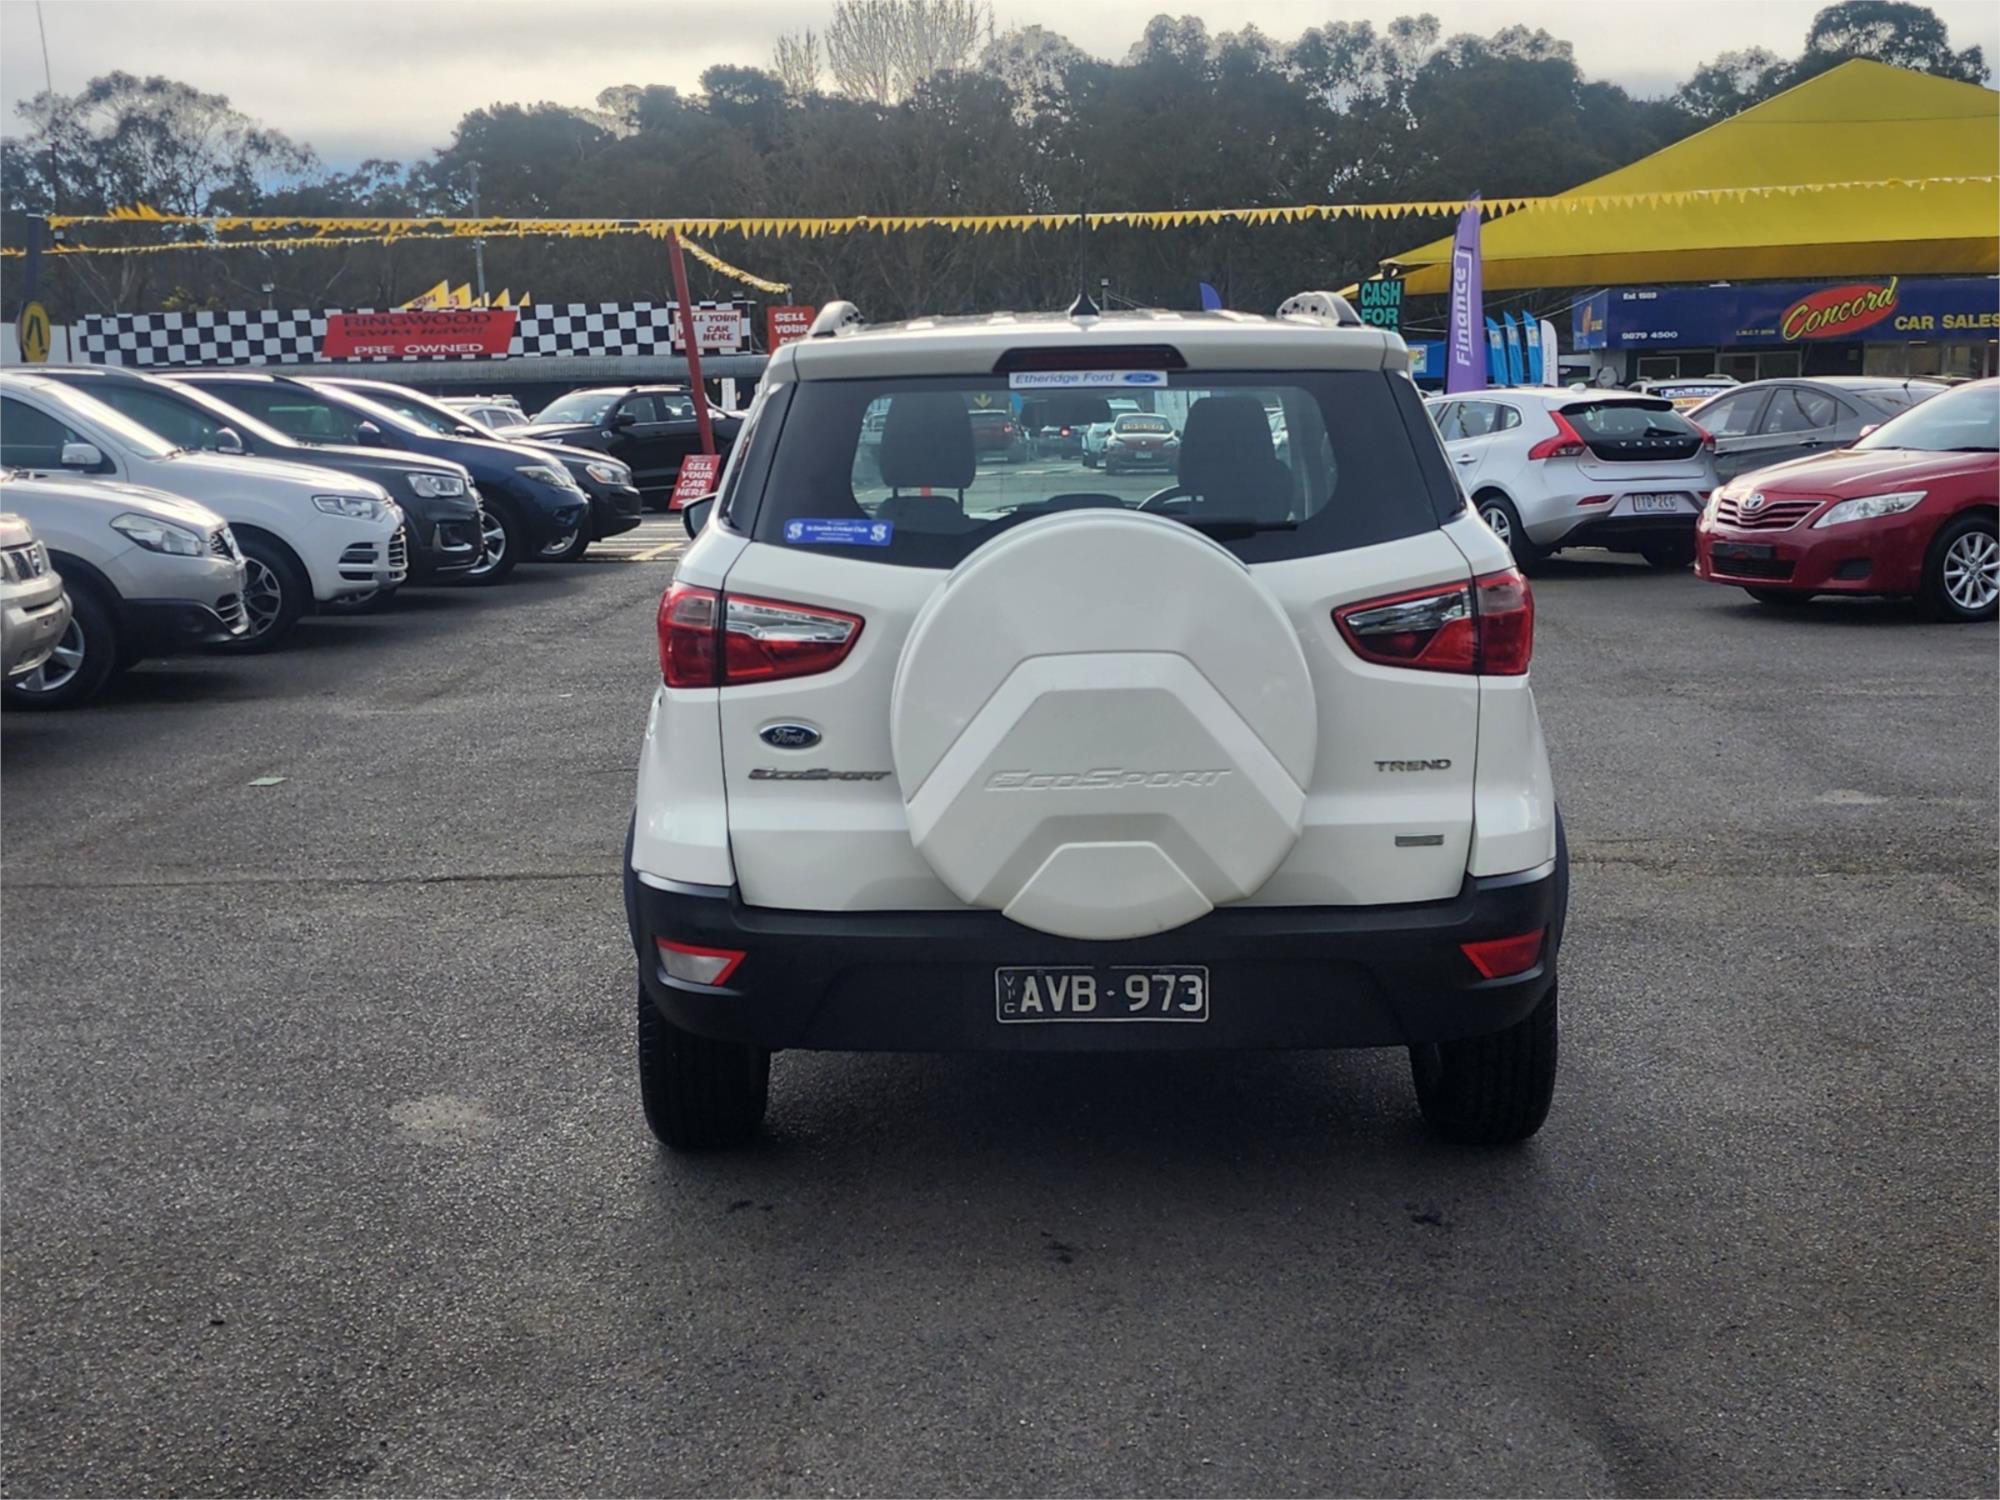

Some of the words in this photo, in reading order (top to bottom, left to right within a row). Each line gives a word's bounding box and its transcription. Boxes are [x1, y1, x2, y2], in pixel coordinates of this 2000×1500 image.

[1361, 281, 1401, 306] CASH
[1783, 276, 1898, 342] Concord
[343, 312, 492, 328] RINGWOOD
[709, 314, 738, 322] YOUR
[774, 312, 807, 322] SELL
[1361, 308, 1398, 325] FOR
[1455, 267, 1471, 367] Finance
[1894, 315, 1935, 331] CAR
[1941, 312, 2000, 329] SALES
[774, 324, 809, 334] YOUR
[703, 333, 734, 341] HERE
[1650, 331, 1678, 339] 4500
[354, 345, 395, 355] PRE
[403, 343, 484, 354] OWNED
[1015, 374, 1079, 384] Etheridge
[1083, 373, 1115, 382] Ford
[1619, 440, 1684, 448] VOLVO
[687, 462, 713, 470] SELL
[681, 471, 713, 480] YOUR
[680, 479, 706, 488] CAR
[675, 488, 707, 497] HERE
[1374, 759, 1451, 772] TREND
